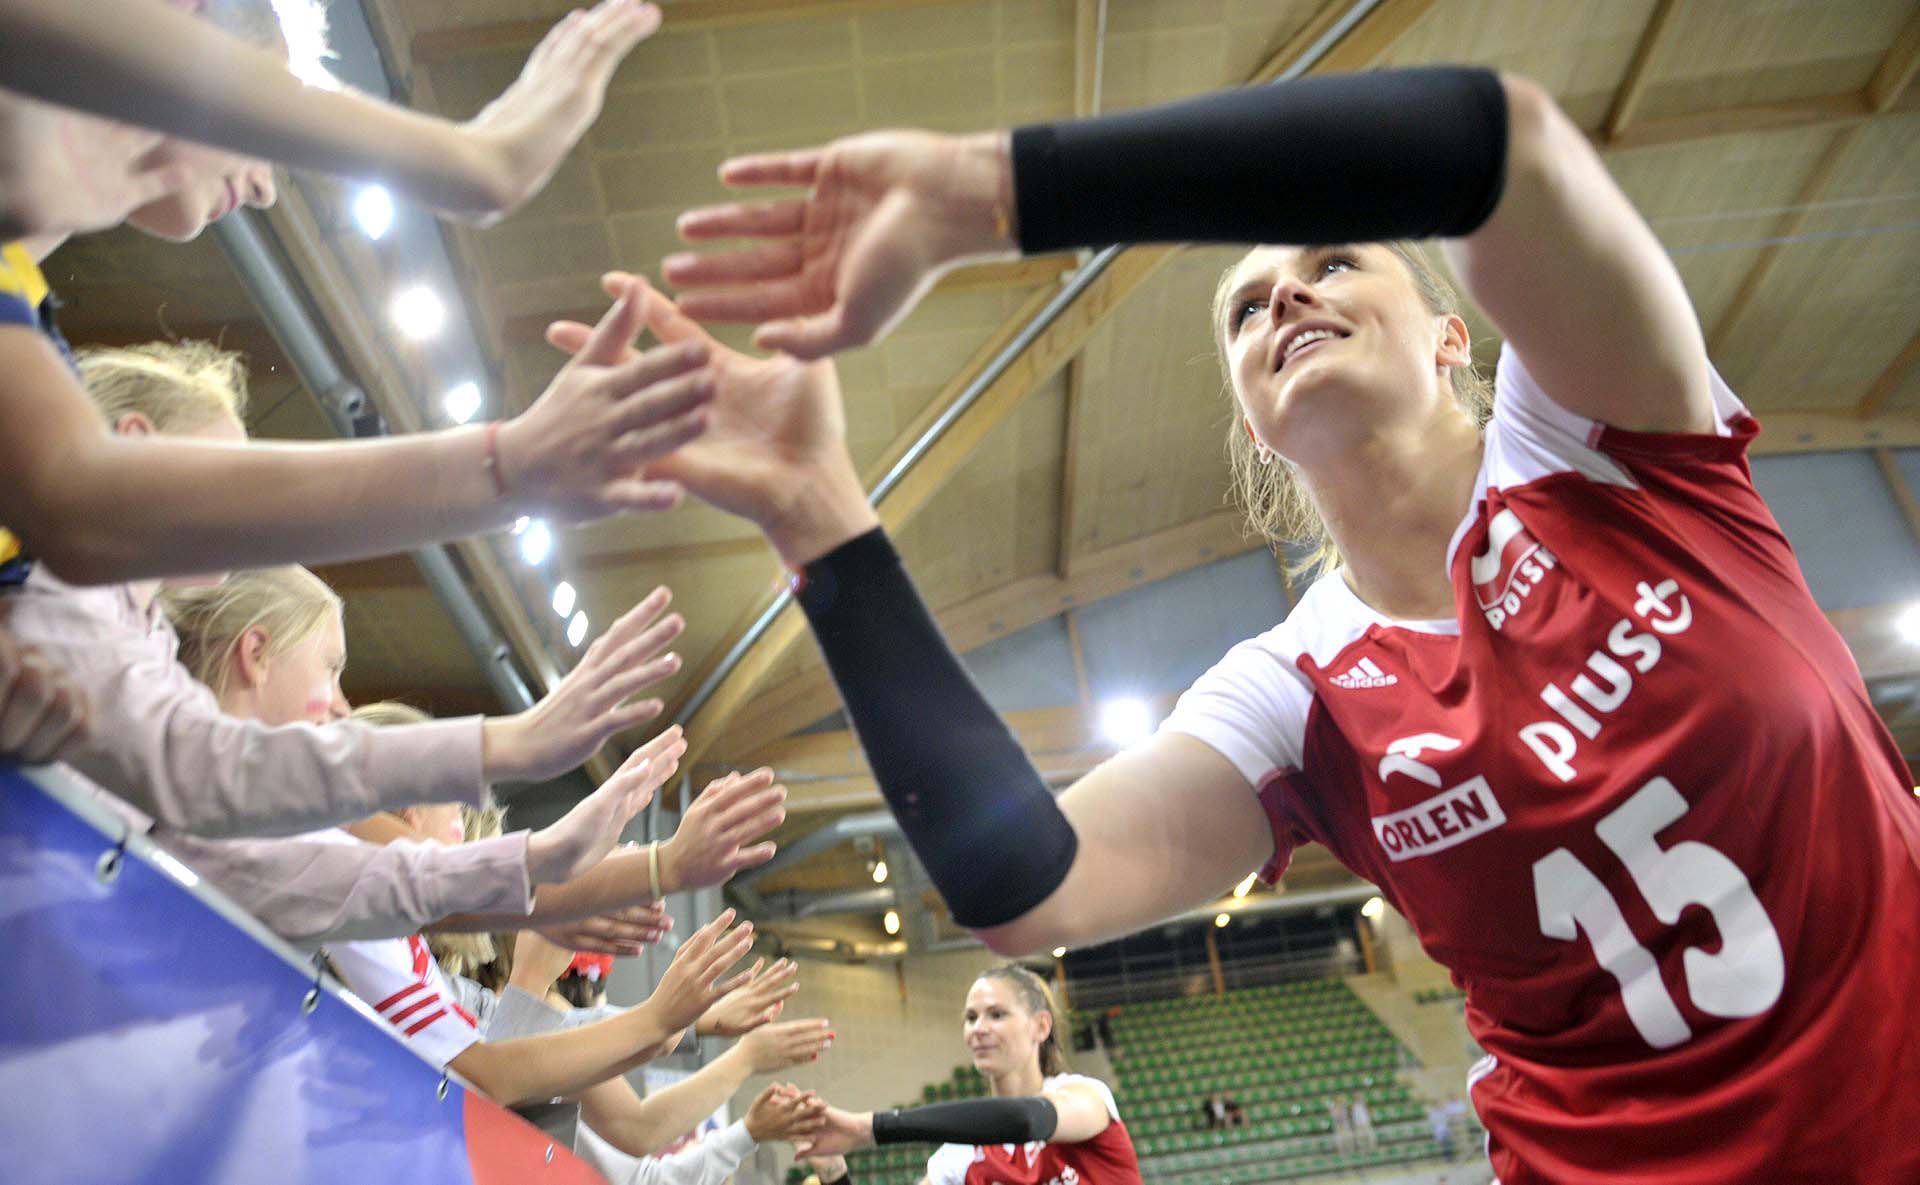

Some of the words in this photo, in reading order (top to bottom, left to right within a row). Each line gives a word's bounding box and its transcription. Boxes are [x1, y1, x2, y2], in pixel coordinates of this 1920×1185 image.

[1328, 674, 1398, 689] adidas
[1382, 789, 1489, 854] ORLEN
[1532, 776, 1785, 1049] 15
